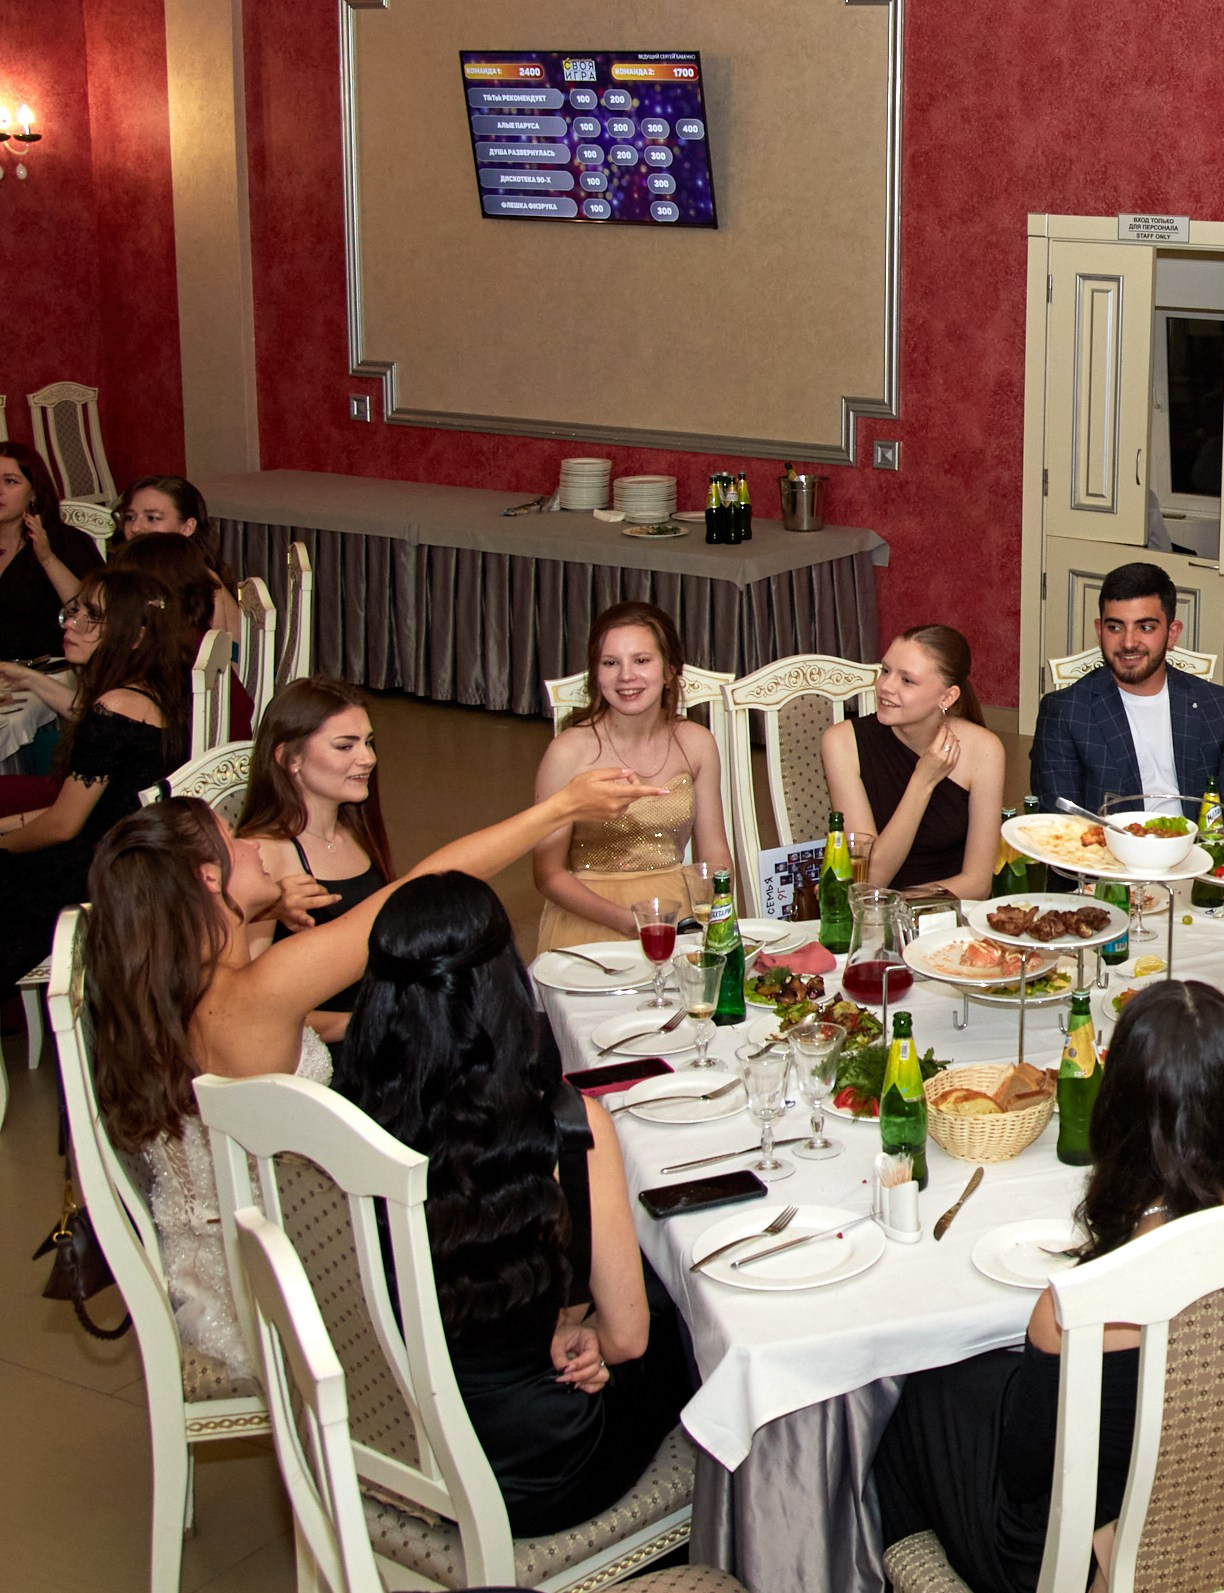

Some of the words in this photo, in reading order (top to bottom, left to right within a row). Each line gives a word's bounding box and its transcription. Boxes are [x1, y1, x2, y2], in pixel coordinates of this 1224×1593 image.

[564, 61, 594, 70] СВОЯ
[519, 68, 540, 76] 2400
[566, 71, 595, 80] ИГРА
[615, 68, 648, 76] КОМАНДА
[673, 68, 694, 77] 1700
[580, 123, 593, 131] 100
[648, 124, 662, 132] 300
[683, 125, 698, 133] 400
[617, 151, 631, 159] 200
[651, 152, 666, 160] 300
[654, 180, 669, 188] 300
[658, 207, 672, 215] 300
[765, 877, 775, 914] СЕМЬЯ
